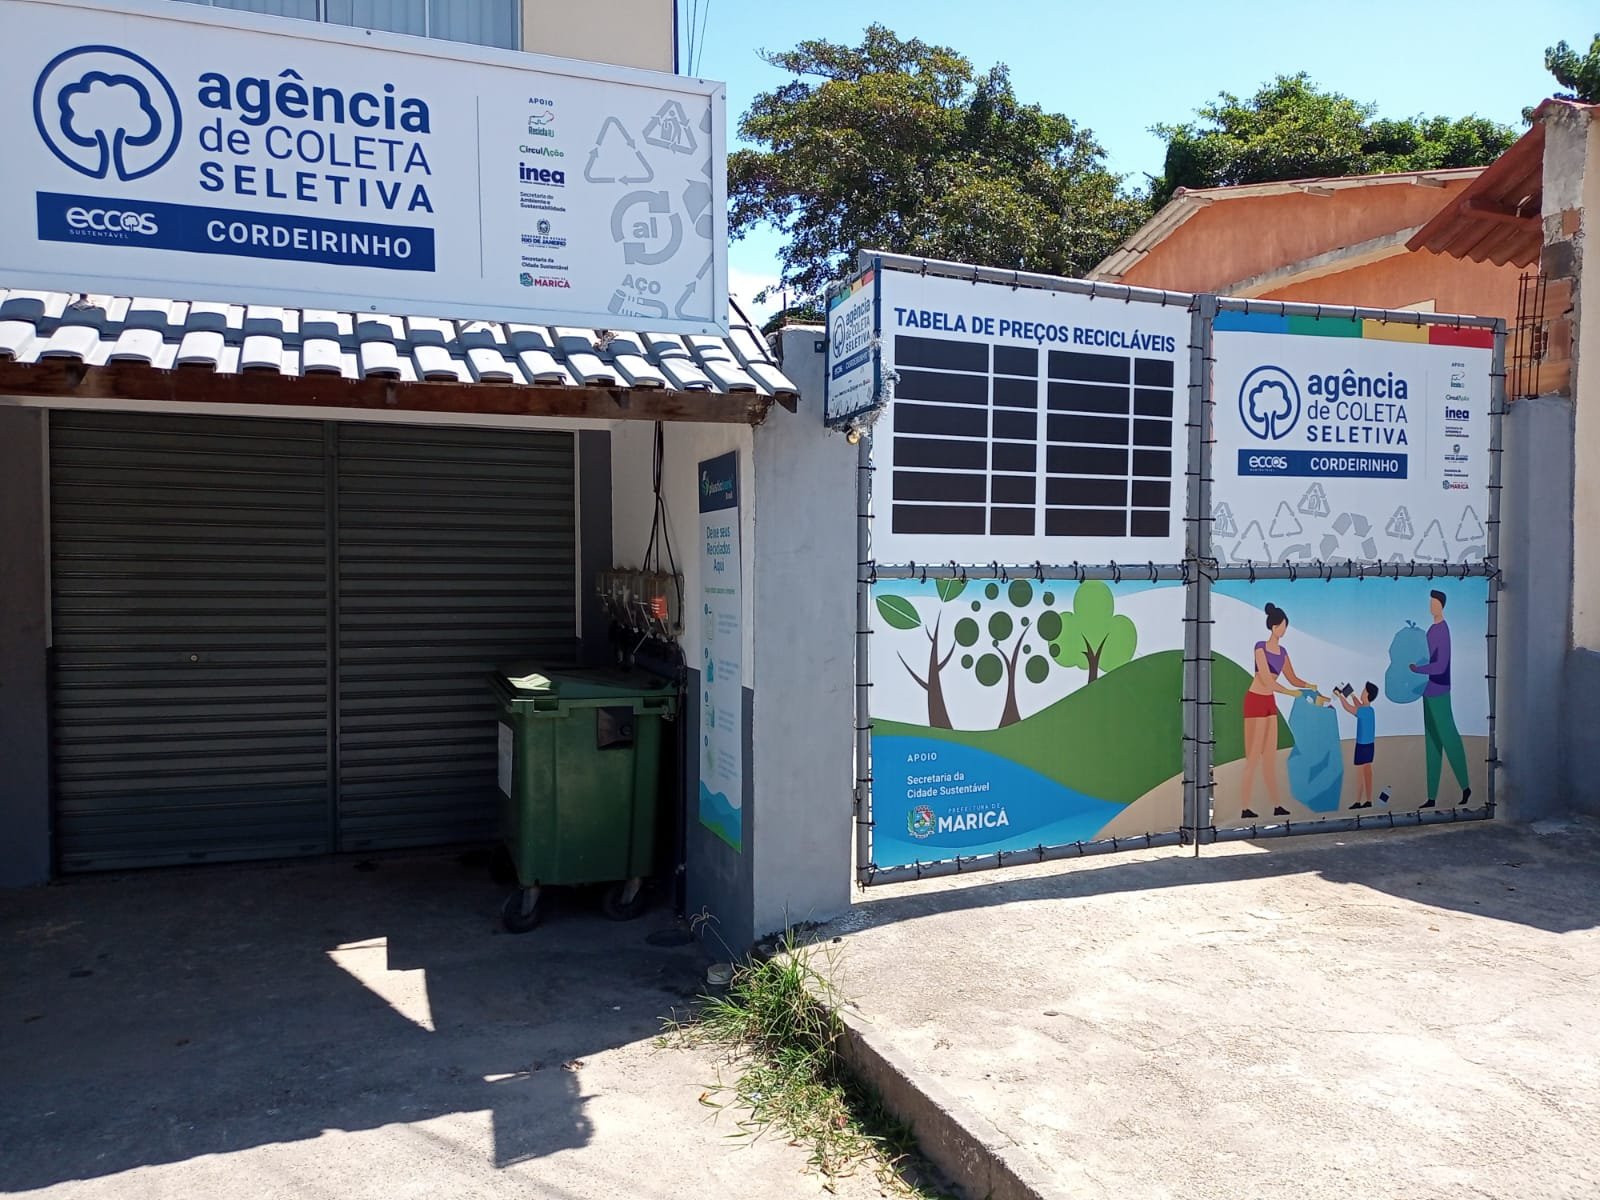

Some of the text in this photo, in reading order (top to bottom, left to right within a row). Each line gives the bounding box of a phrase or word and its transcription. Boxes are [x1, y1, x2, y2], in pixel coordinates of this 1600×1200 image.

[198, 68, 431, 134] agência
[528, 97, 553, 106] APOIO
[199, 117, 432, 175] de COLETA
[519, 162, 565, 184] inea
[199, 161, 434, 214] SELETIVA
[66, 207, 158, 235] eccos
[69, 229, 129, 239] SUSTENTÁVEL
[206, 220, 412, 260] CORDEIRINHO
[534, 278, 571, 288] MARICÁ
[622, 274, 661, 294] AÇO
[846, 297, 870, 327] agência
[894, 307, 1176, 353] TABELA DE PREÇOS RECICLÁVEIS
[846, 330, 870, 354] SELETIVA
[1307, 368, 1408, 403] agência
[1307, 400, 1408, 424] de COLETA
[1445, 406, 1470, 419] inea
[1306, 425, 1408, 446] SELETIVA
[1310, 457, 1399, 473] CORDEIRINHO
[907, 752, 937, 762] APOIO
[907, 771, 965, 785] Secretaria da
[907, 782, 990, 798] Cidade Sustentável
[948, 804, 989, 813] PREFEITURA
[938, 807, 1009, 834] MARICÁ
